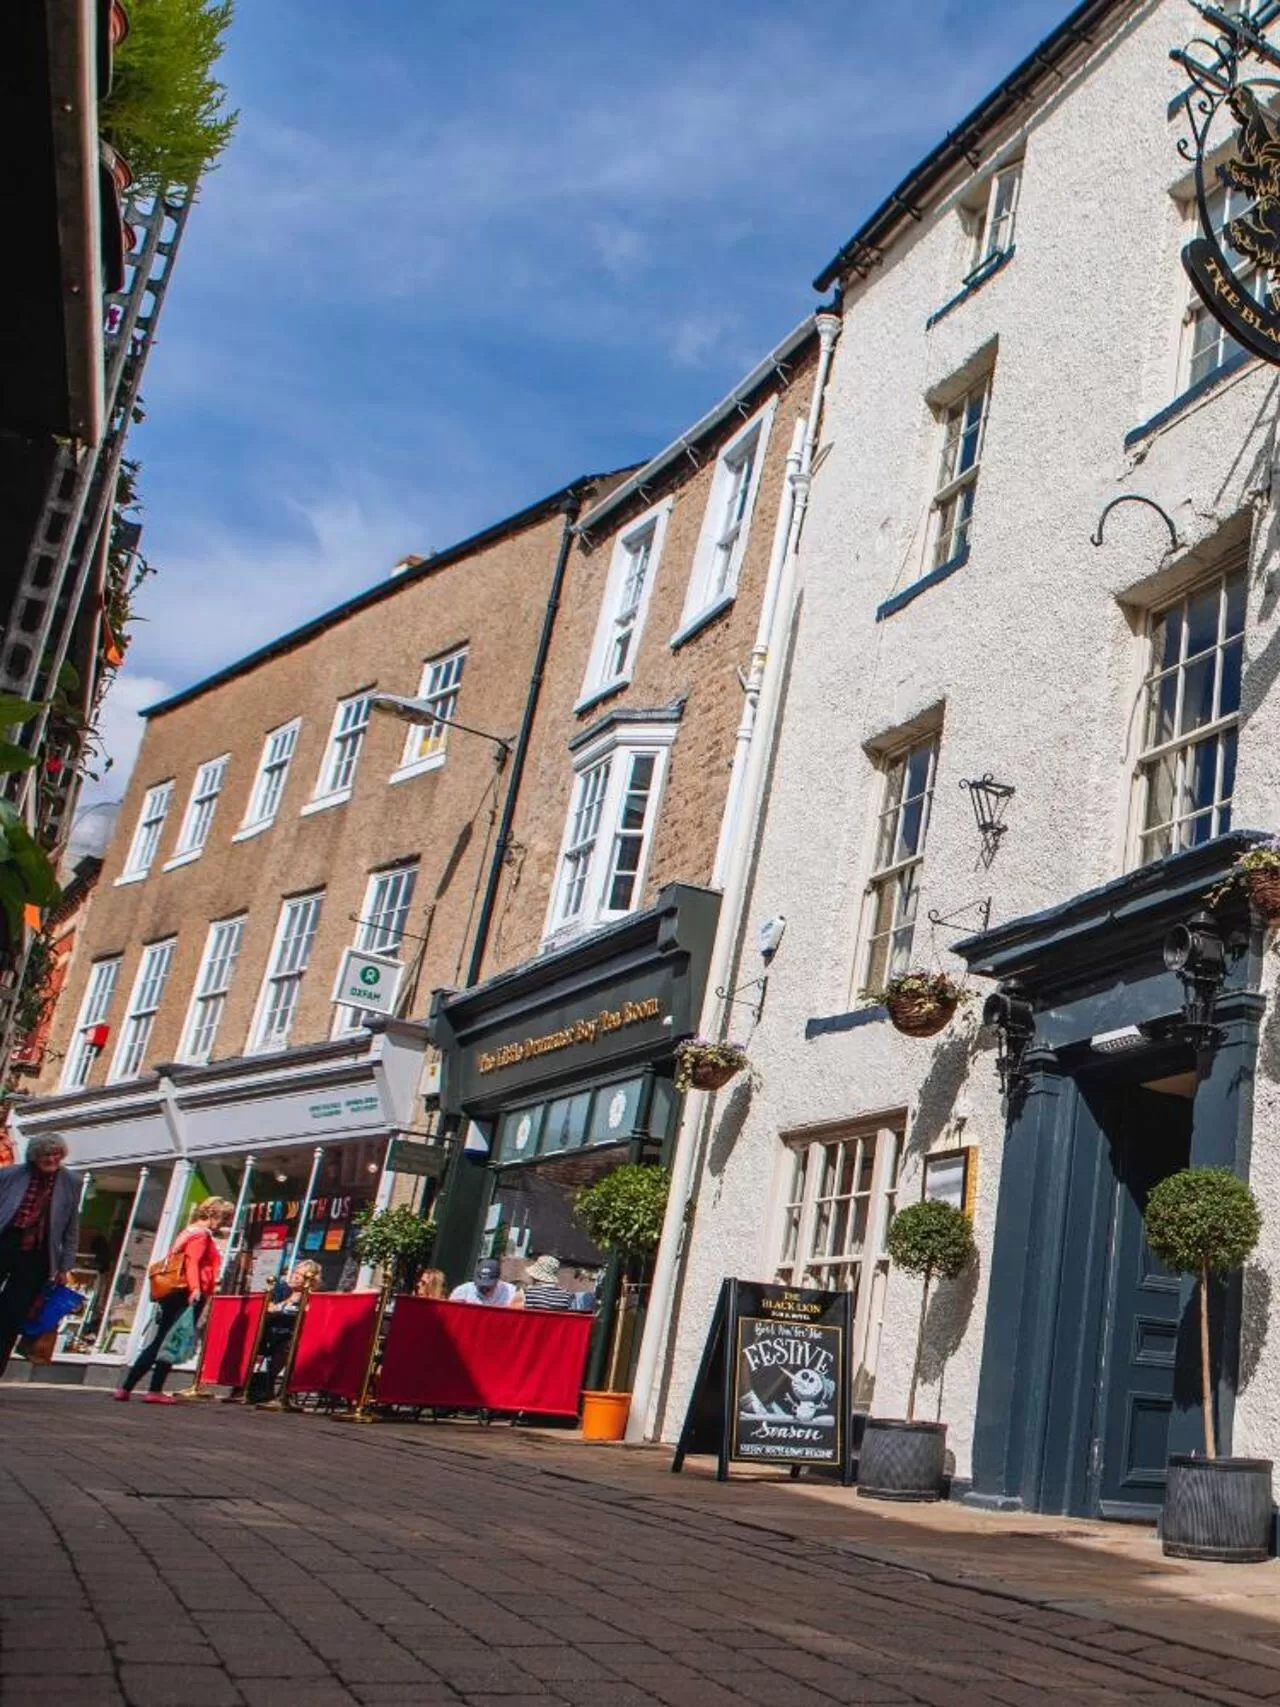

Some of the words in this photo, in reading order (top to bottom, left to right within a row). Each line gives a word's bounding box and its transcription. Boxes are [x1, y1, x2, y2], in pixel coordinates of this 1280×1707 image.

[1204, 257, 1240, 309] THE
[350, 987, 381, 1001] OXFAM
[286, 1199, 328, 1221] WTH
[331, 1196, 351, 1219] US
[761, 1299, 795, 1310] BLACK
[797, 1303, 821, 1314] LION
[742, 1338, 834, 1375] FESTIVE
